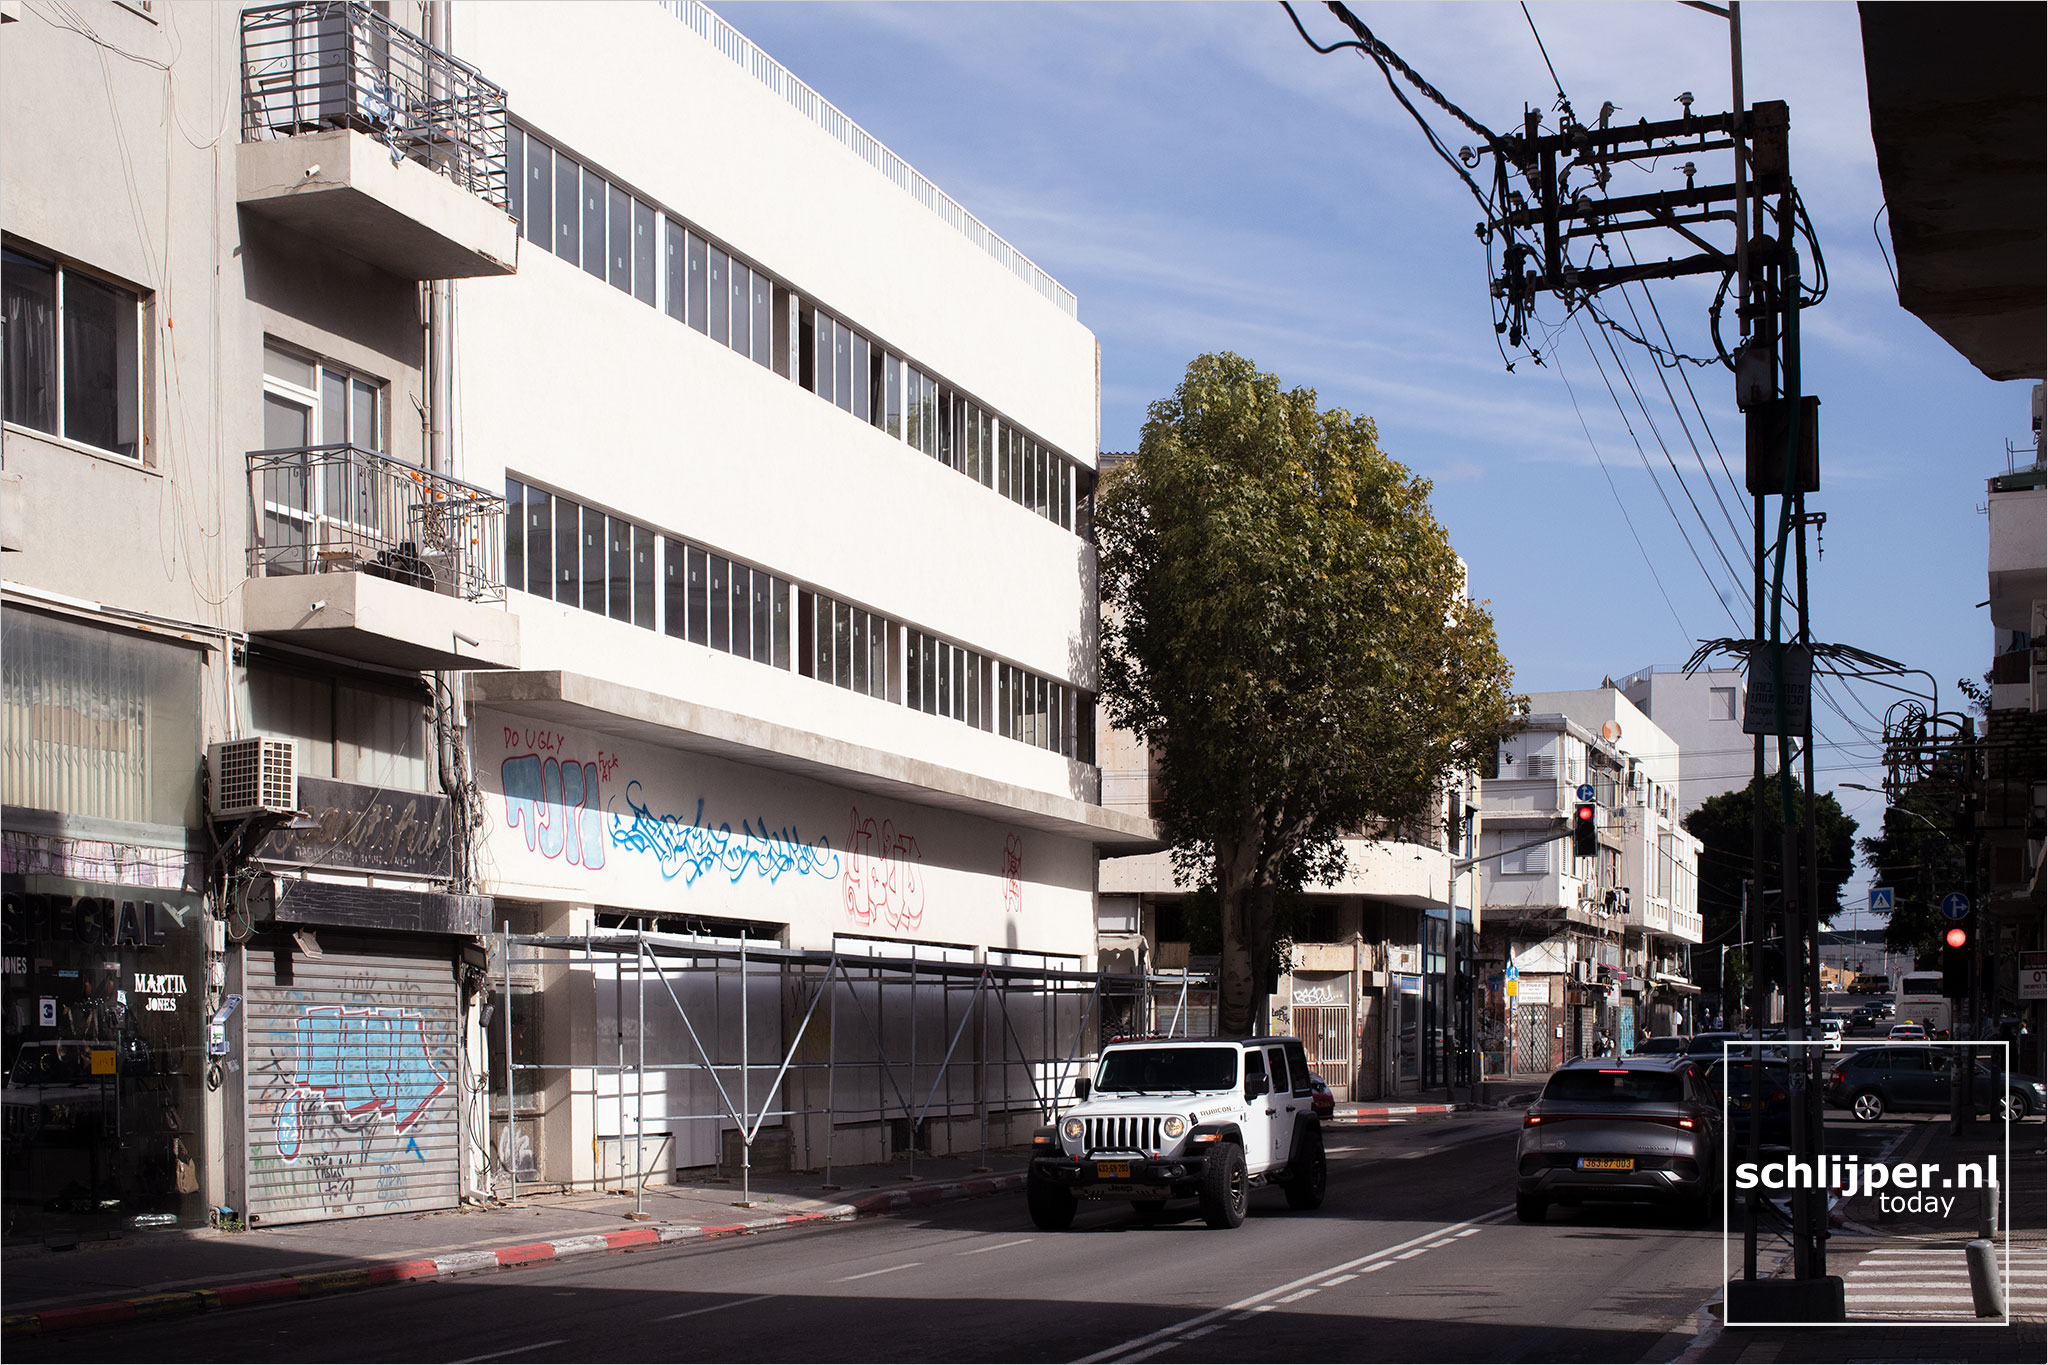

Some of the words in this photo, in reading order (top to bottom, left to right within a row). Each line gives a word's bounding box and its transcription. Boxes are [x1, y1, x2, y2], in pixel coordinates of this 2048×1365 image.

[503, 726, 520, 749] DO
[526, 728, 565, 755] UGLY
[2, 892, 166, 947] SPECIAL
[145, 997, 177, 1012] JONES
[1199, 1106, 1232, 1117] RUBICON
